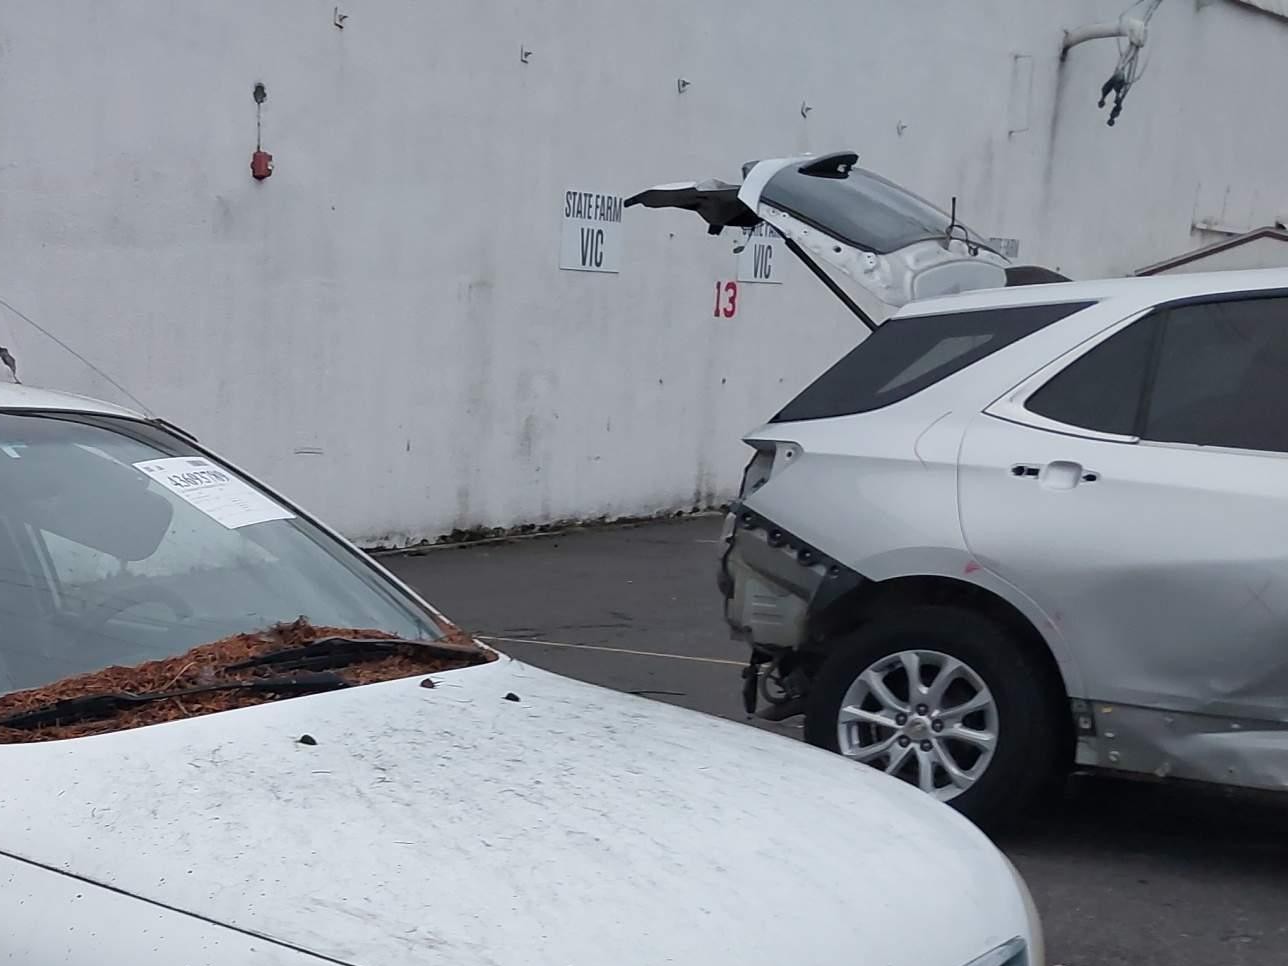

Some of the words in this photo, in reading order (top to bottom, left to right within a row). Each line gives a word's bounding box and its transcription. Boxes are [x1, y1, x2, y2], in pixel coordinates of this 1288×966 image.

[565, 190, 593, 220] STATE
[594, 194, 623, 223] FARM
[580, 227, 604, 267] VIC
[753, 243, 773, 280] VIC
[714, 281, 737, 318] 13
